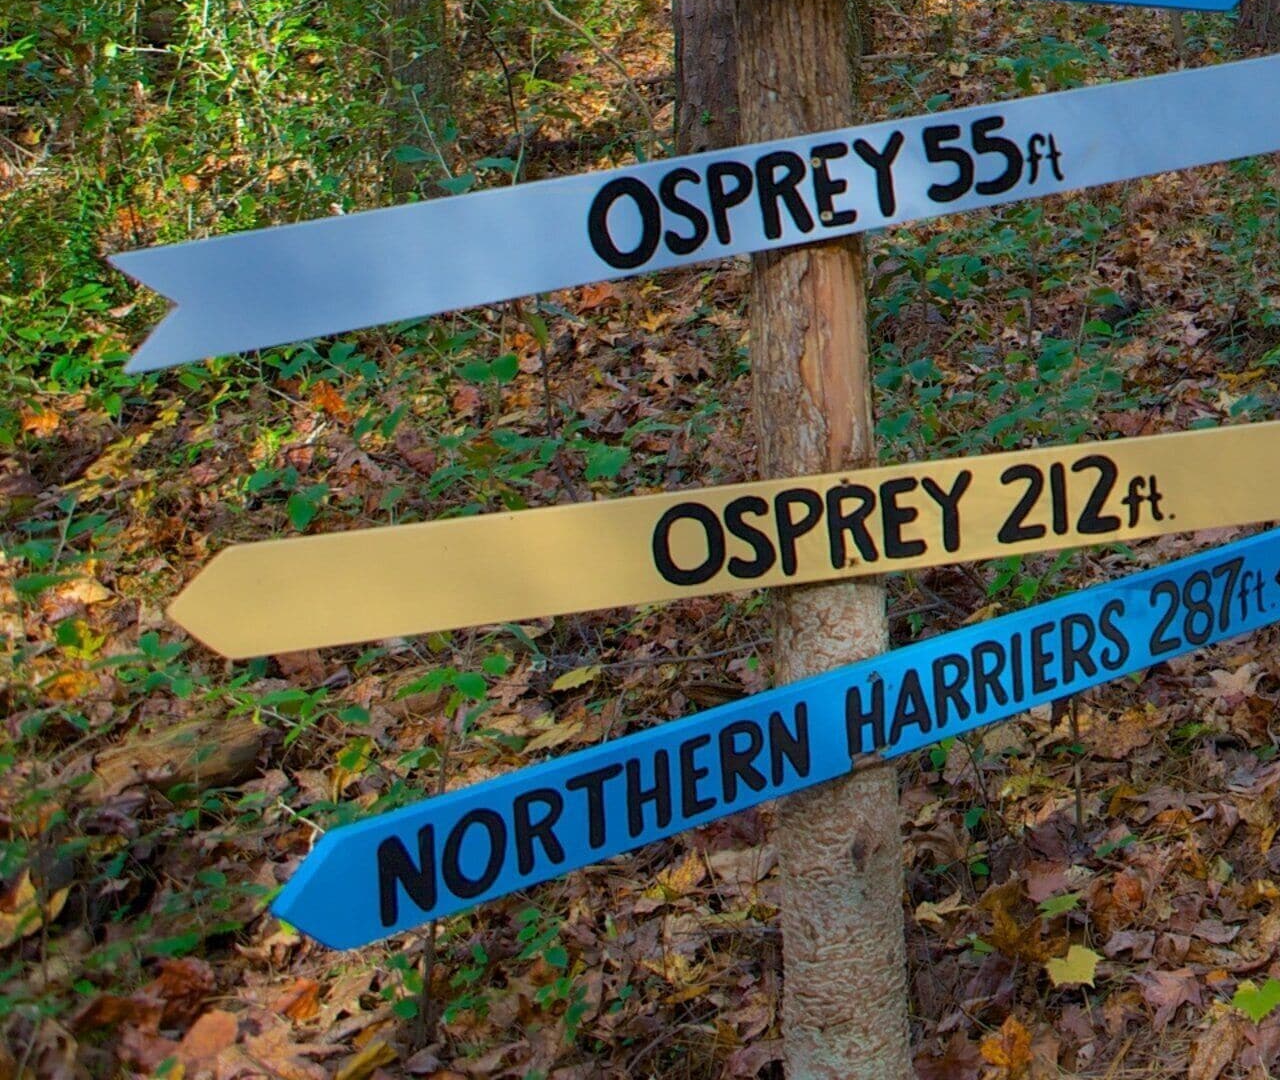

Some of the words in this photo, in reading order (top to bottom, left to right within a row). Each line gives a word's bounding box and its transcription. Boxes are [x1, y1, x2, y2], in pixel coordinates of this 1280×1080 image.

[587, 131, 904, 269] OSPREY
[652, 470, 972, 586] OSPREY
[377, 701, 810, 927] NORTHERN
[845, 599, 1129, 757] HARRIERS
